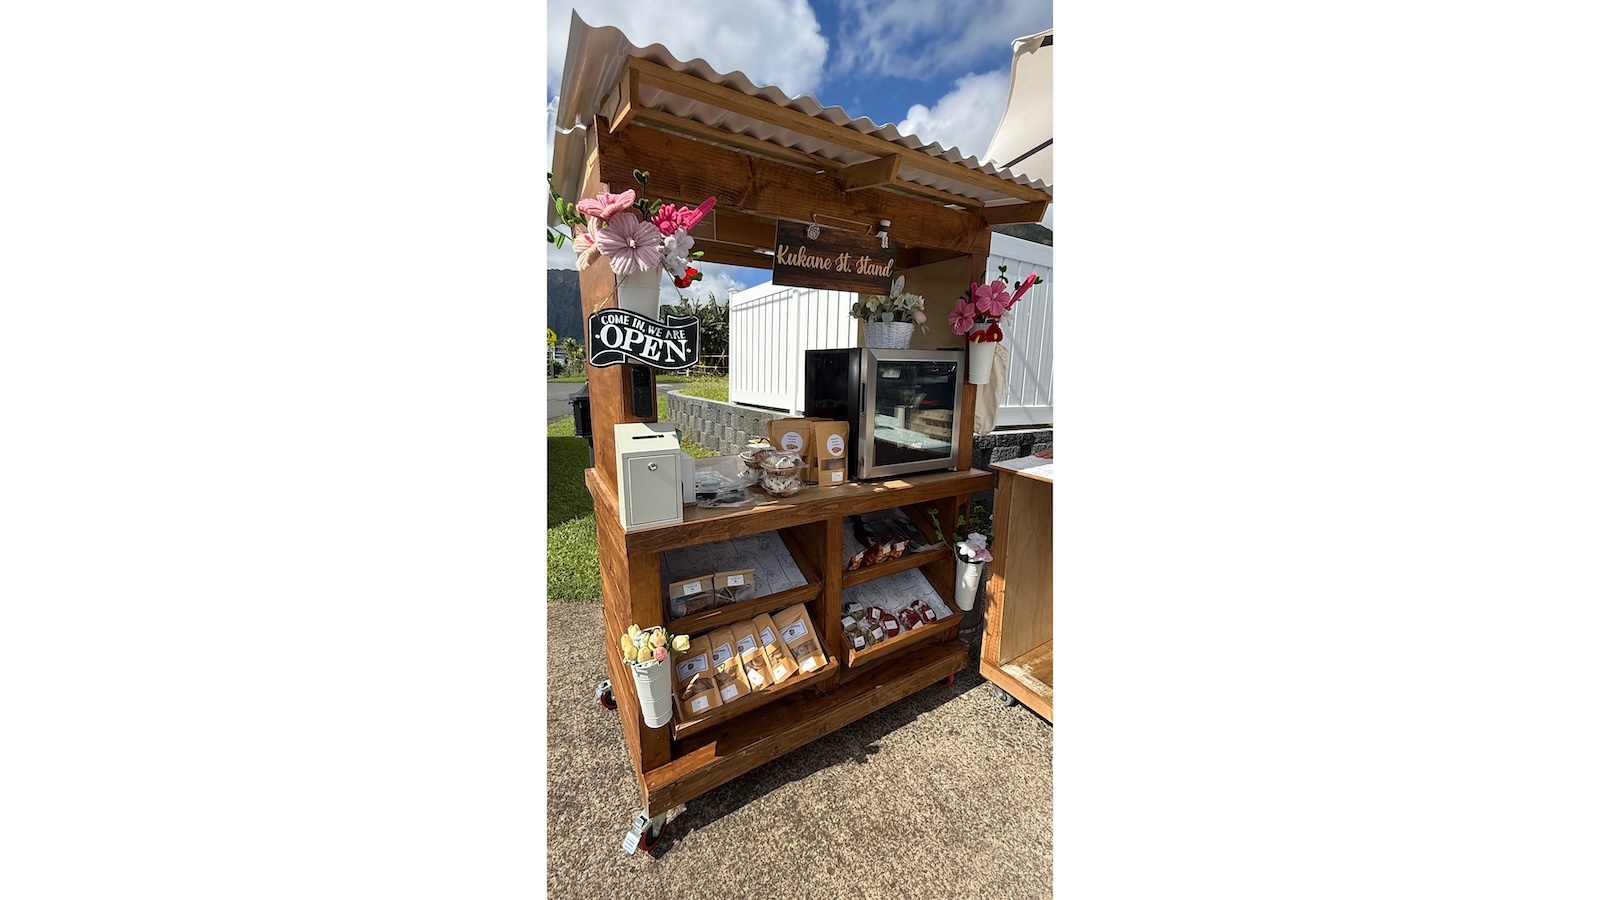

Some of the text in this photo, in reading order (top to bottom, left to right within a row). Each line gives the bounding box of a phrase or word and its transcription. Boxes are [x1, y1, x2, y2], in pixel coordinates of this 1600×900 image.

[776, 244, 895, 277] Kukane St. Stand
[600, 324, 688, 362] OPEN
[601, 314, 630, 325] COME
[648, 325, 663, 337] WE
[665, 329, 687, 340] ARE
